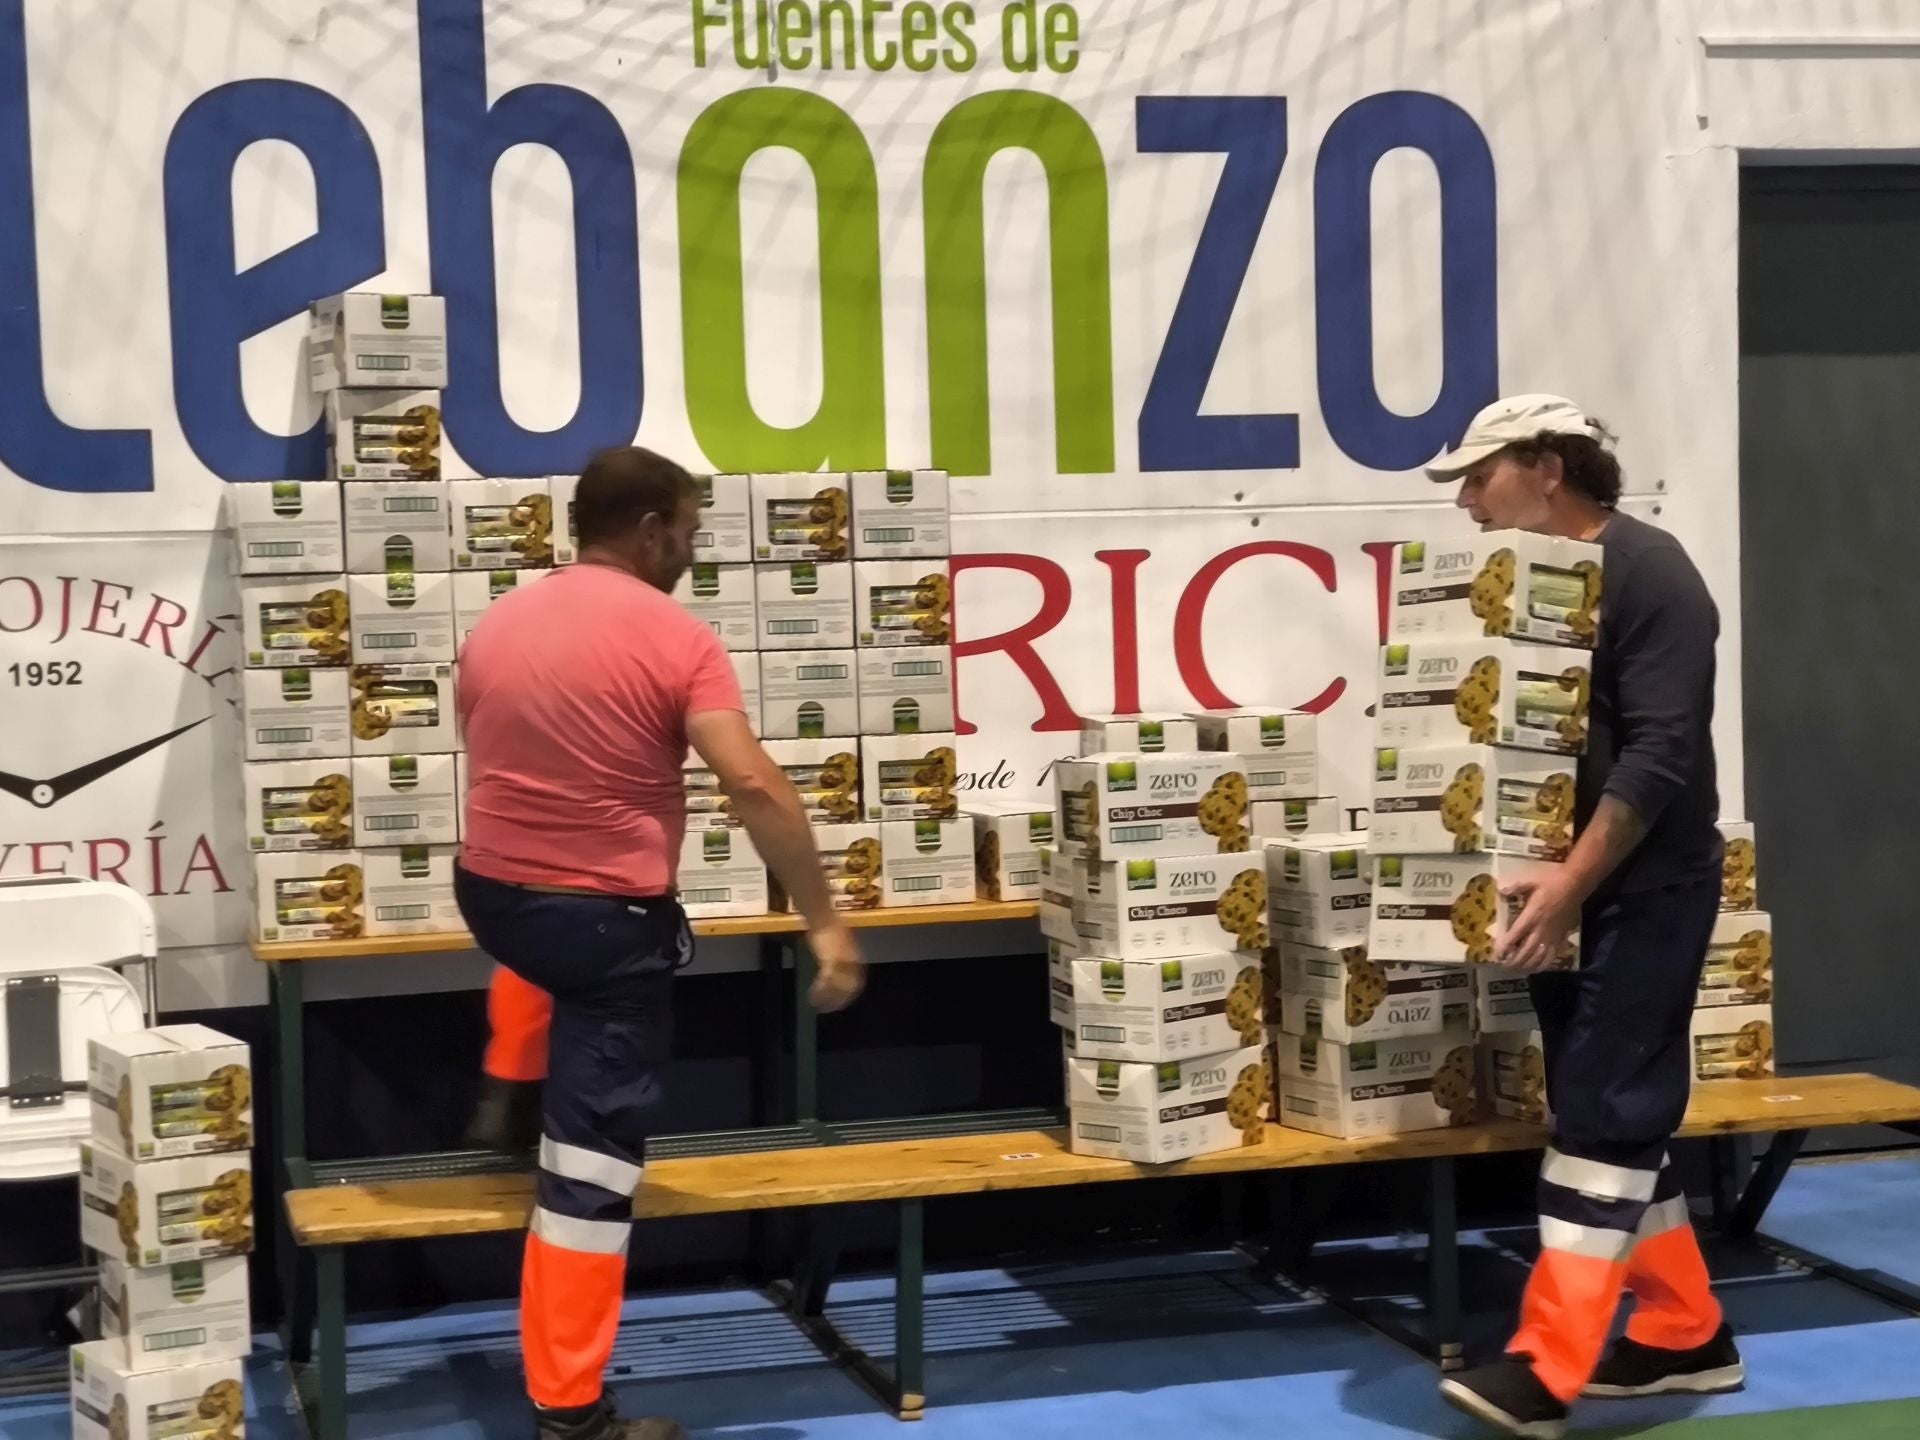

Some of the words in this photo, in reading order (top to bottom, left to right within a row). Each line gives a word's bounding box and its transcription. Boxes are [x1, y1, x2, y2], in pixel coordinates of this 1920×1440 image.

[692, 0, 977, 73] Fuentes
[1001, 0, 1079, 73] de
[0, 575, 240, 706] OJERÍ
[8, 660, 83, 687] 1952
[1149, 772, 1197, 790] zero
[1110, 808, 1135, 821] Chip
[1137, 806, 1163, 817] Choc
[1169, 870, 1216, 888] zero
[1412, 871, 1454, 889] zero
[1130, 908, 1155, 920] Chip
[1157, 905, 1188, 916] Choco
[1191, 969, 1225, 988] zero
[1388, 1006, 1431, 1025] zero
[1387, 1050, 1431, 1067] zero
[1190, 1067, 1226, 1087] zero
